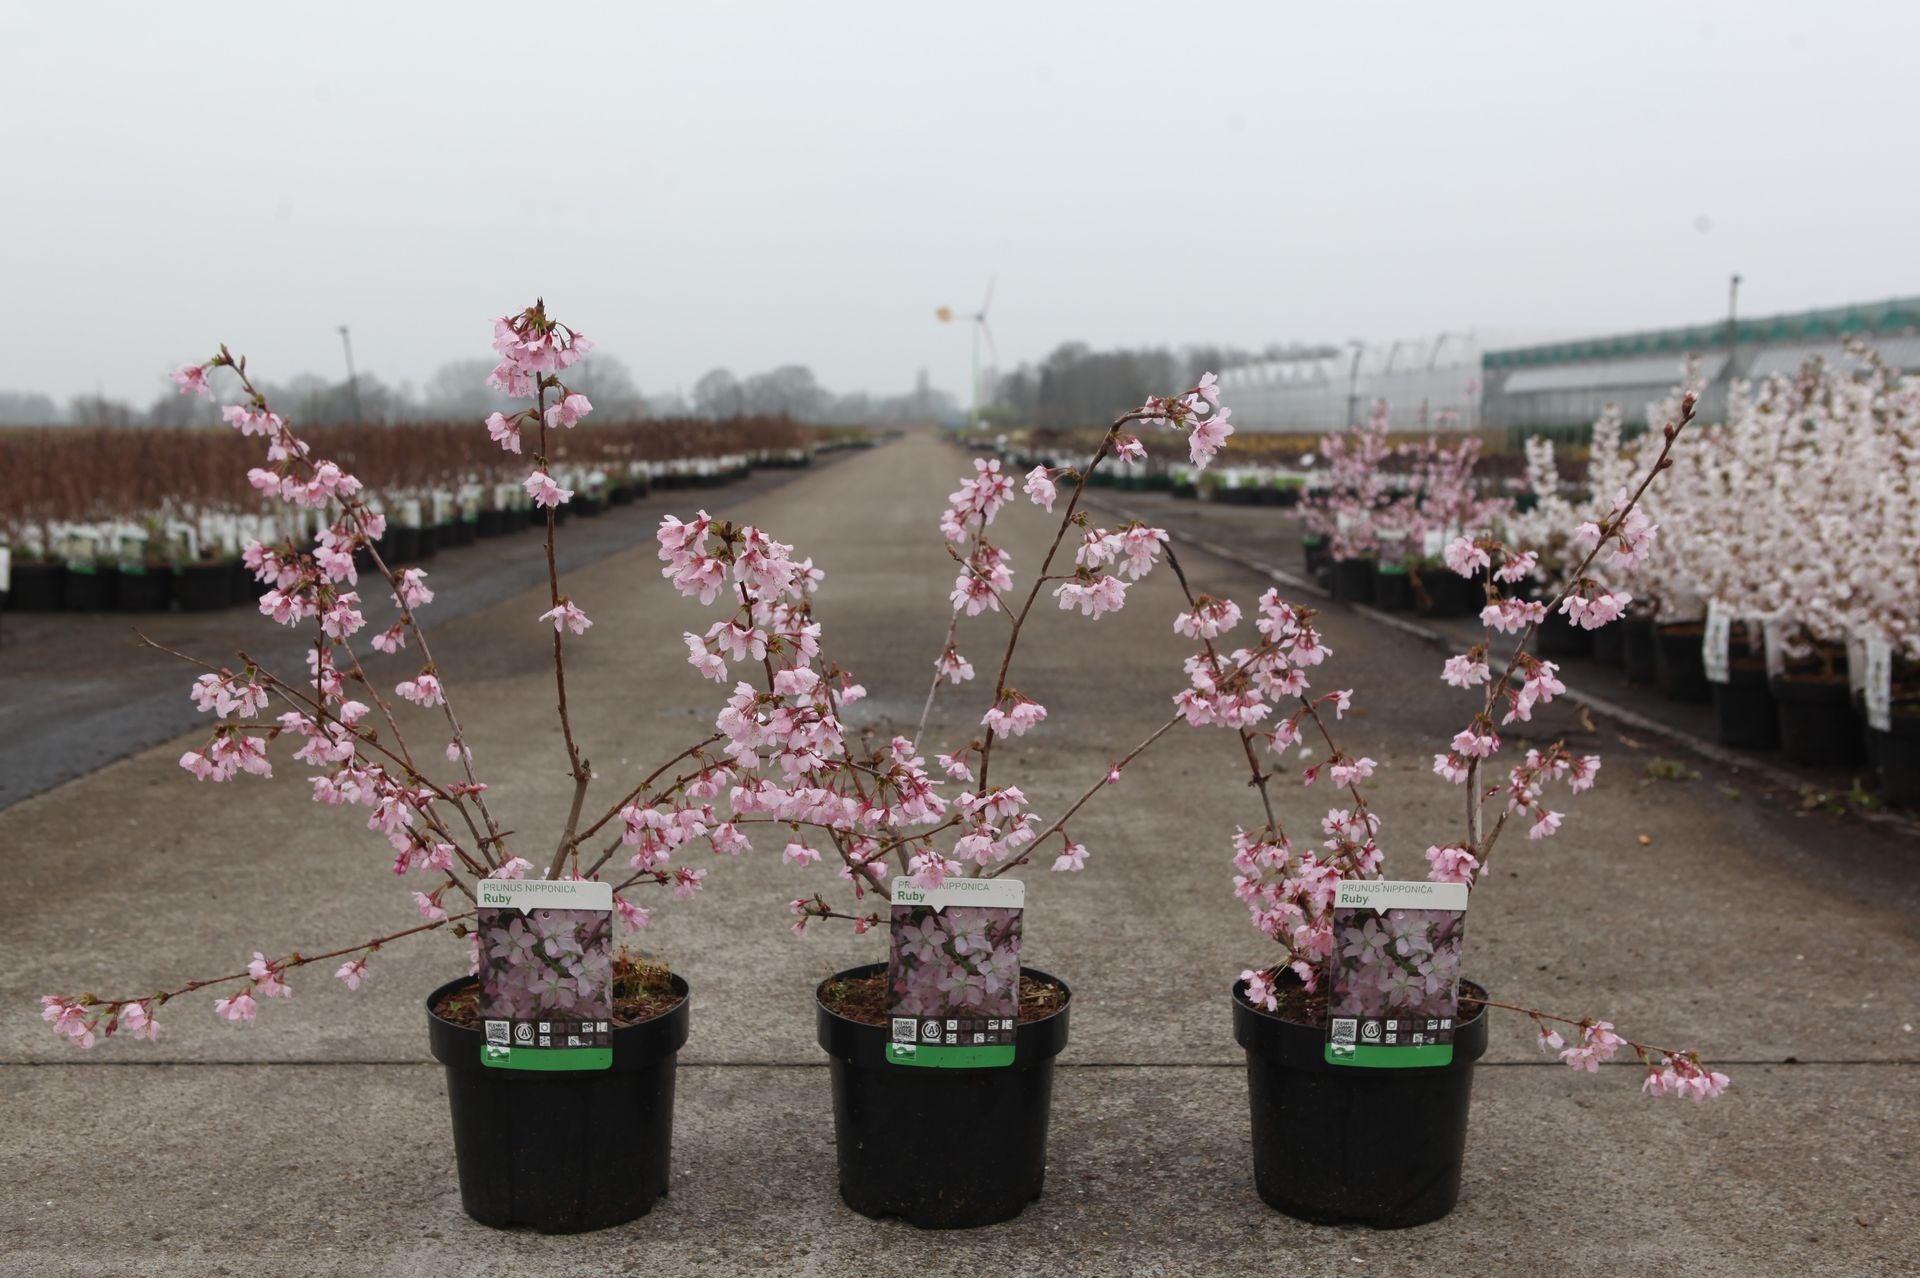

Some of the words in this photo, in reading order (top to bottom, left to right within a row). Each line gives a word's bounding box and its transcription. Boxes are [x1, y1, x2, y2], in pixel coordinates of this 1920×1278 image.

[483, 883, 523, 892] PRUNUS
[525, 884, 577, 894] NIPPONICA
[1341, 883, 1381, 893] PRUNUS
[1383, 885, 1433, 894] NIPPONICA
[483, 893, 512, 905] Ruby
[897, 890, 925, 903] Ruby
[1341, 893, 1369, 905] Ruby
